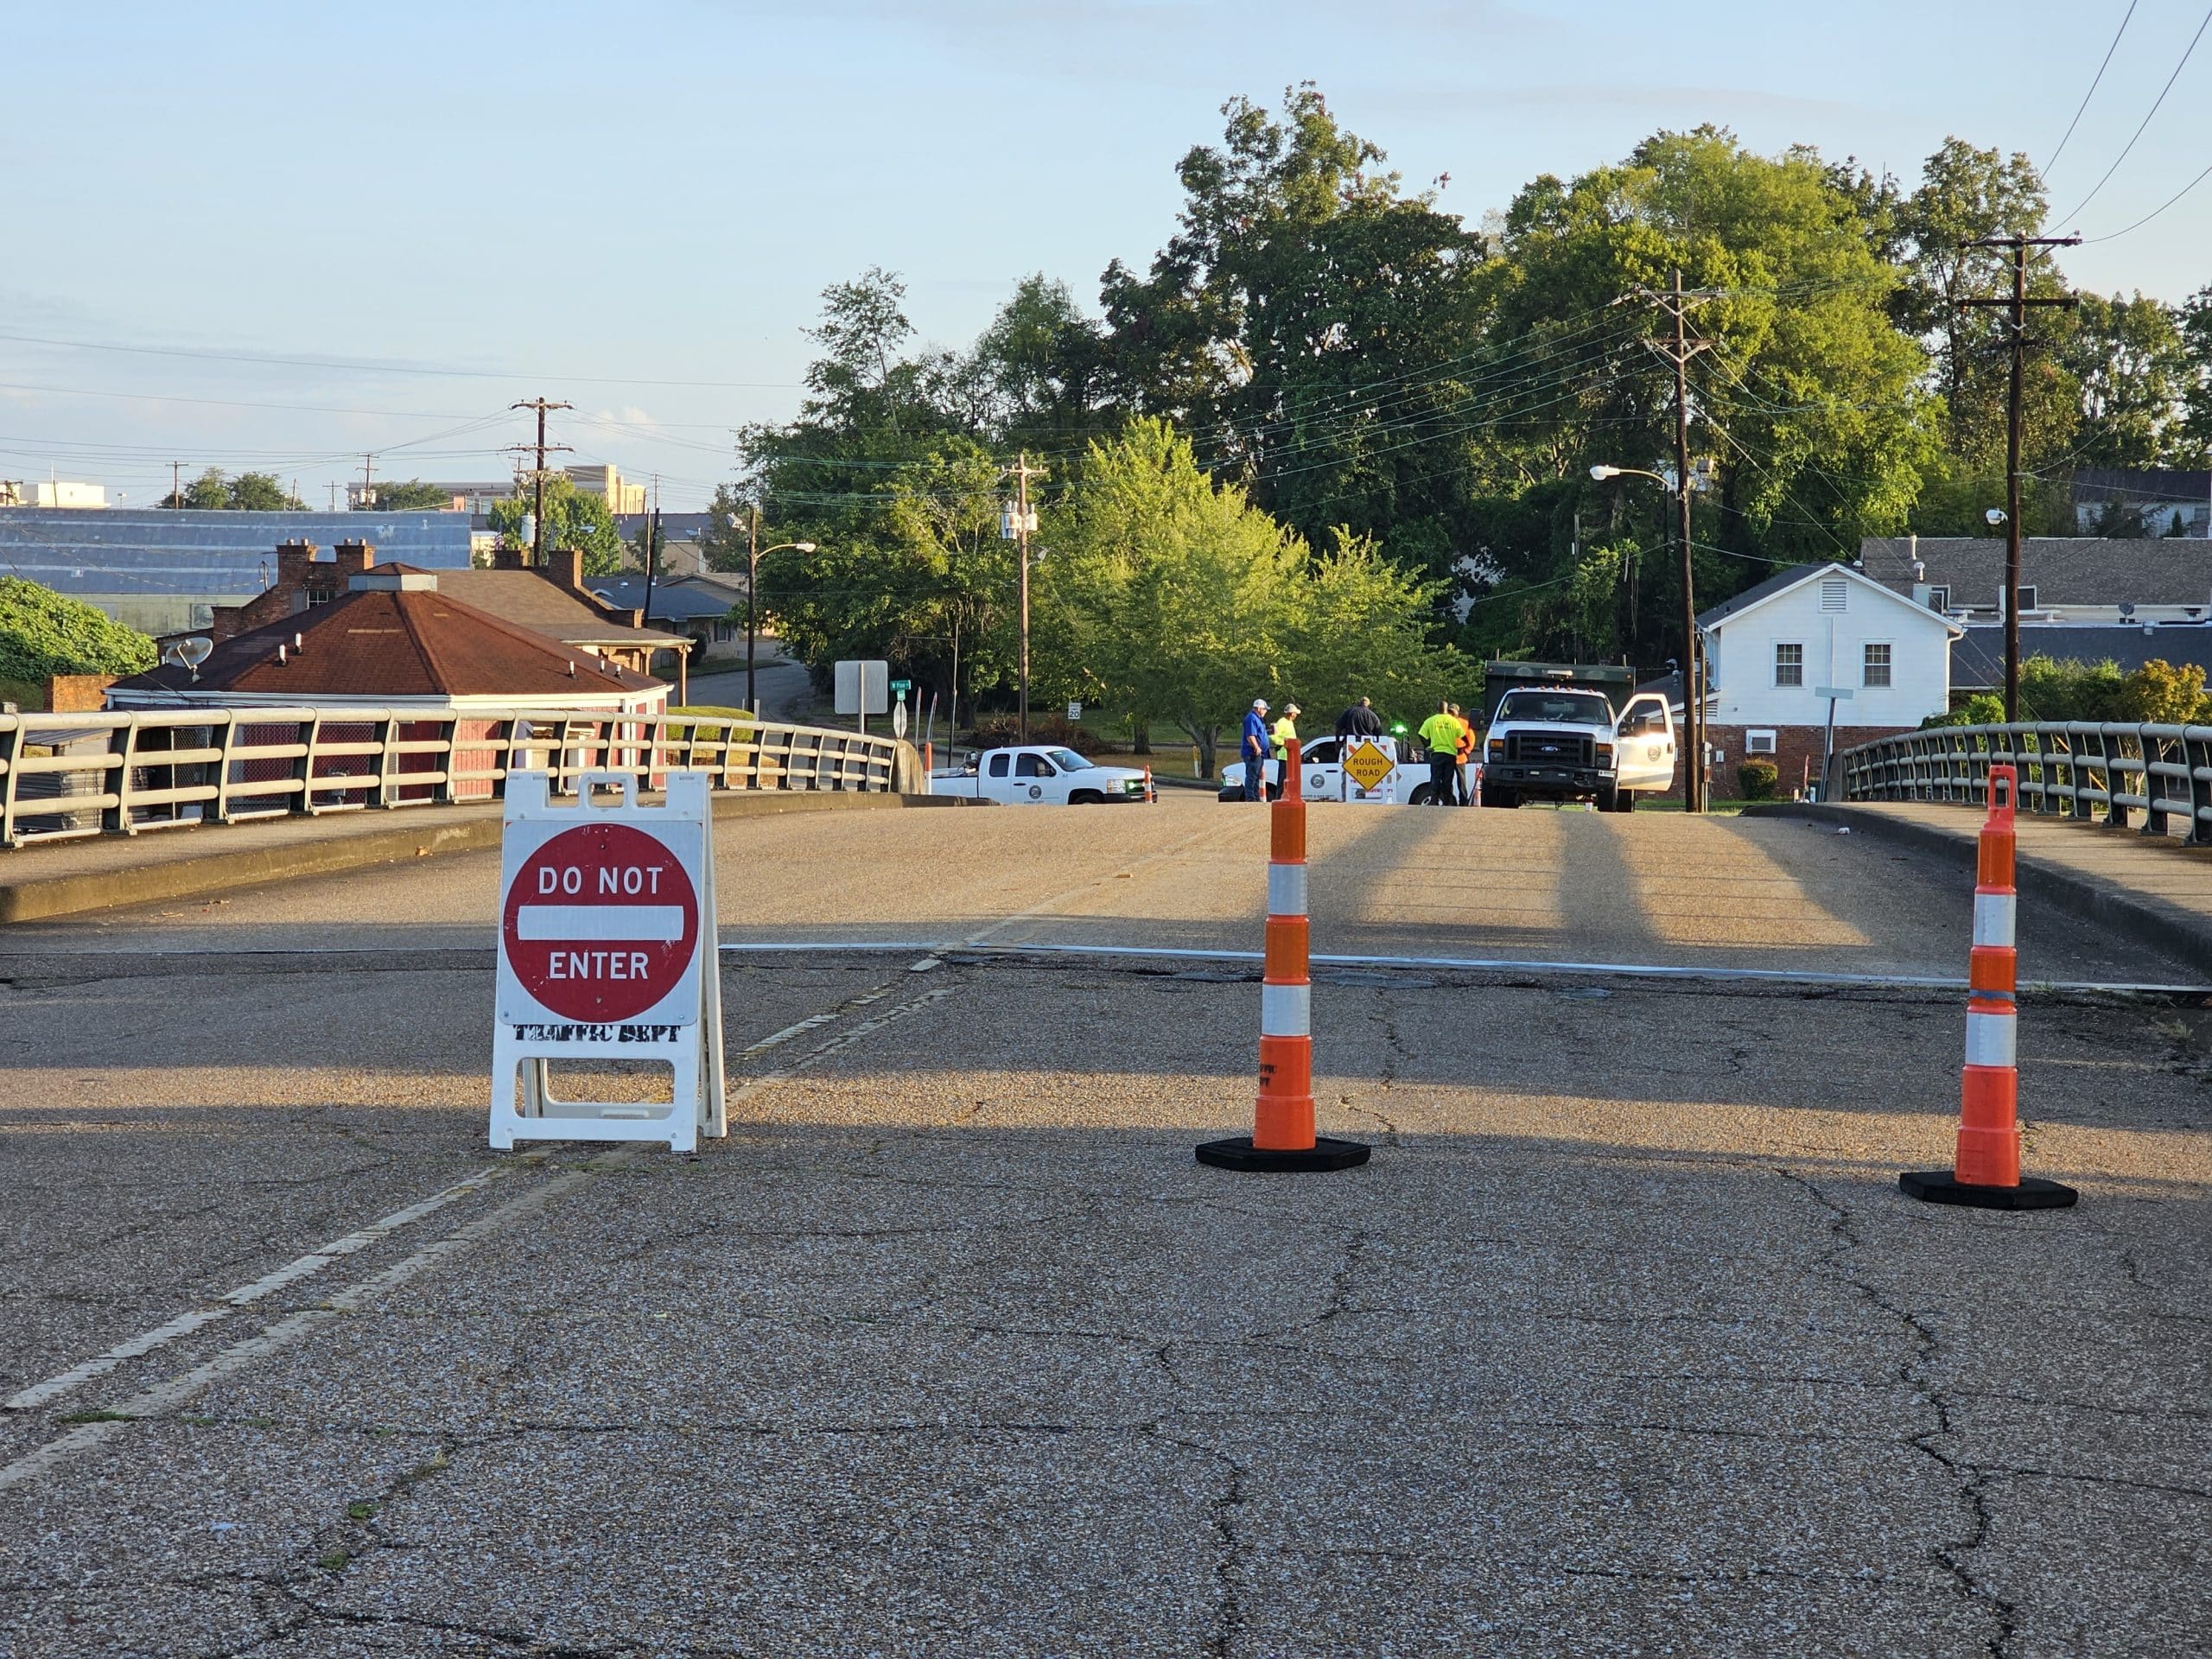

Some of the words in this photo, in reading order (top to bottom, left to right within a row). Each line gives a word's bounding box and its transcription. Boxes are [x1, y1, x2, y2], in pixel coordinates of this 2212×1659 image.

[539, 867, 582, 894] DO
[599, 867, 663, 894] NOT
[550, 951, 648, 979] ENTER
